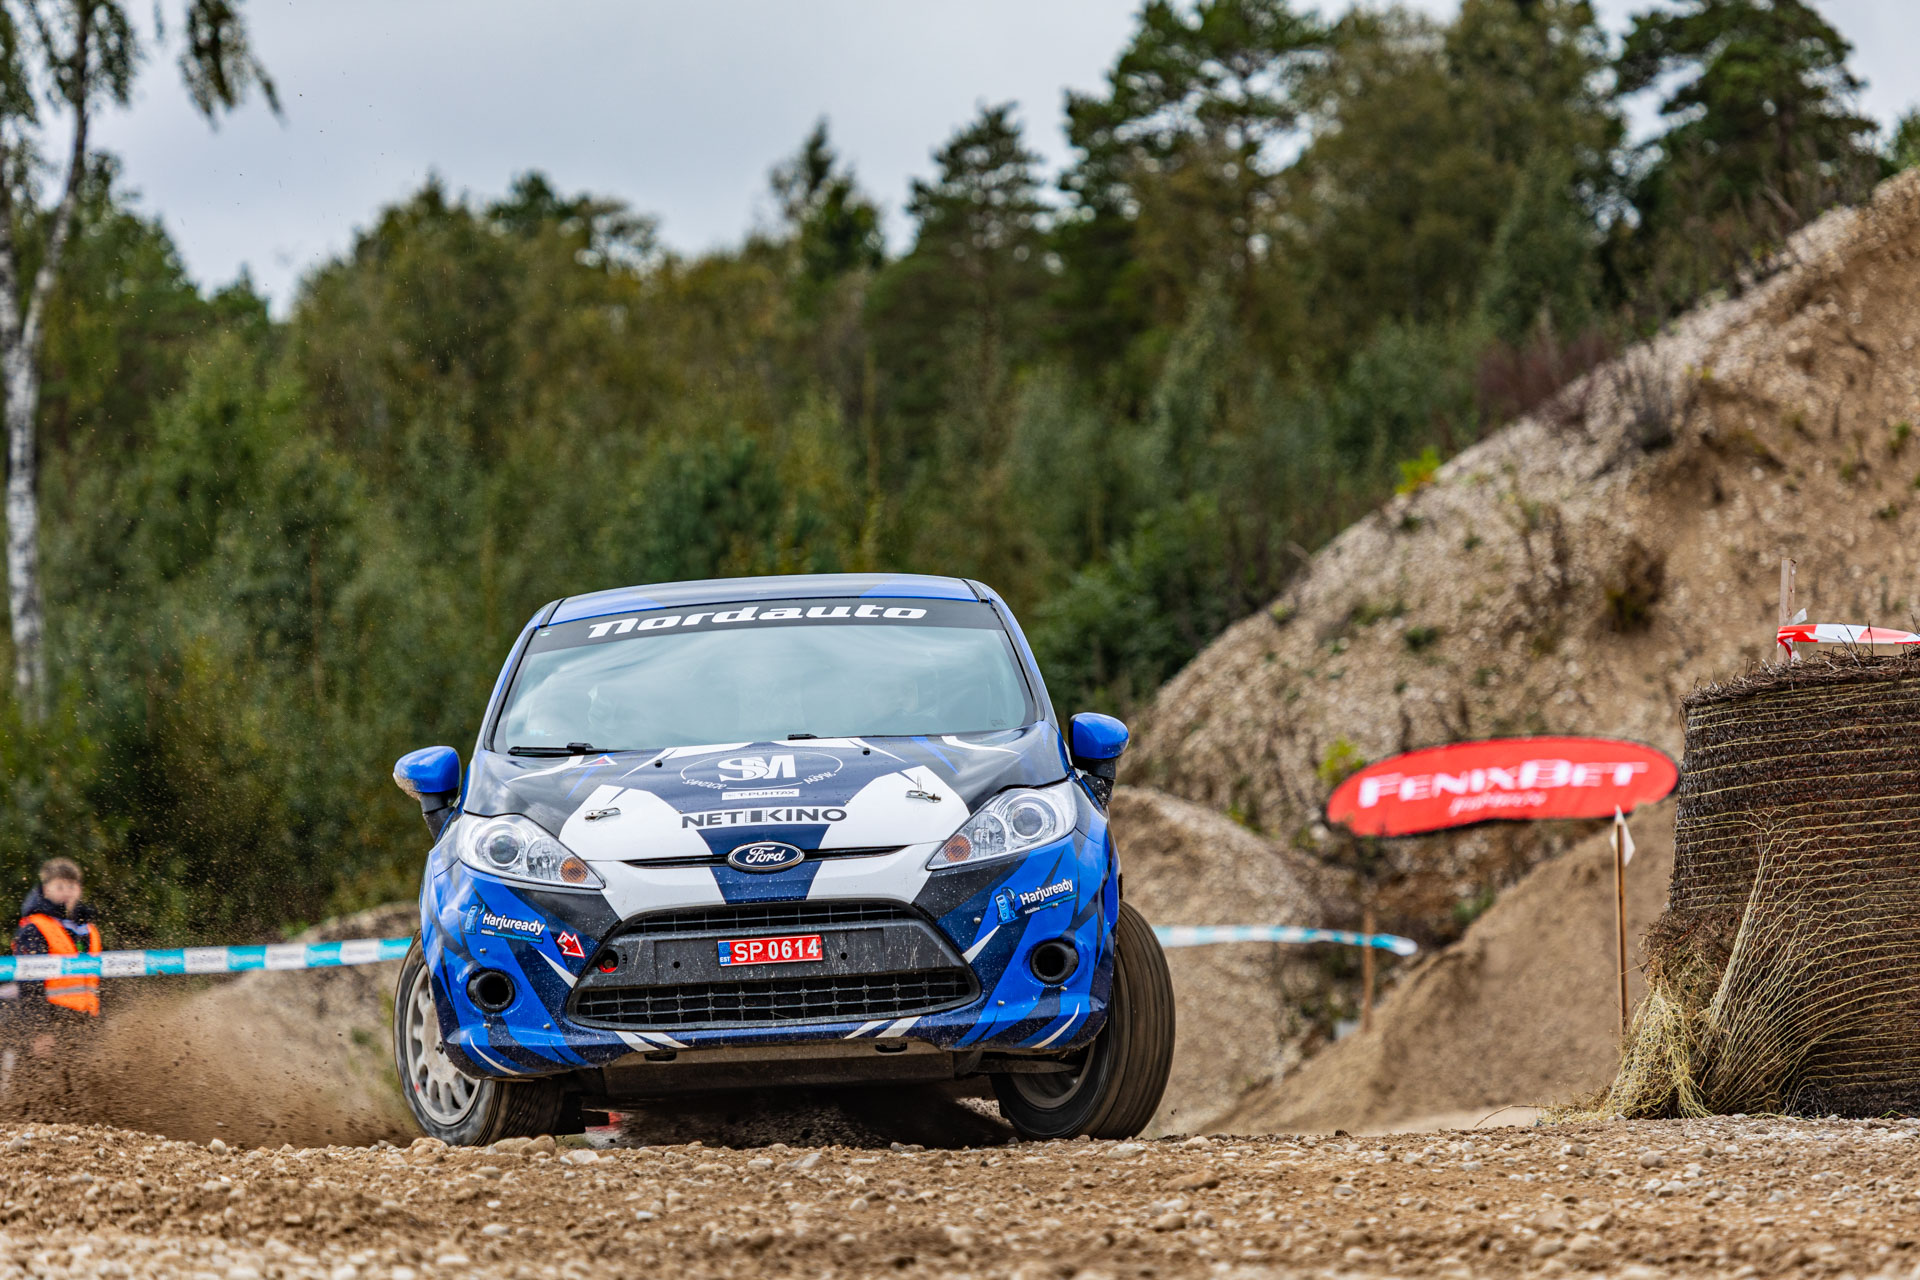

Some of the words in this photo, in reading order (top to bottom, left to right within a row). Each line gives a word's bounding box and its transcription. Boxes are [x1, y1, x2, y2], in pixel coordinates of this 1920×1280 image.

[588, 604, 927, 638] nordauto
[745, 847, 786, 864] Ford
[1019, 878, 1074, 905] Harjuready
[482, 913, 546, 936] Harjuready
[734, 942, 763, 962] SP
[767, 939, 819, 960] 0614
